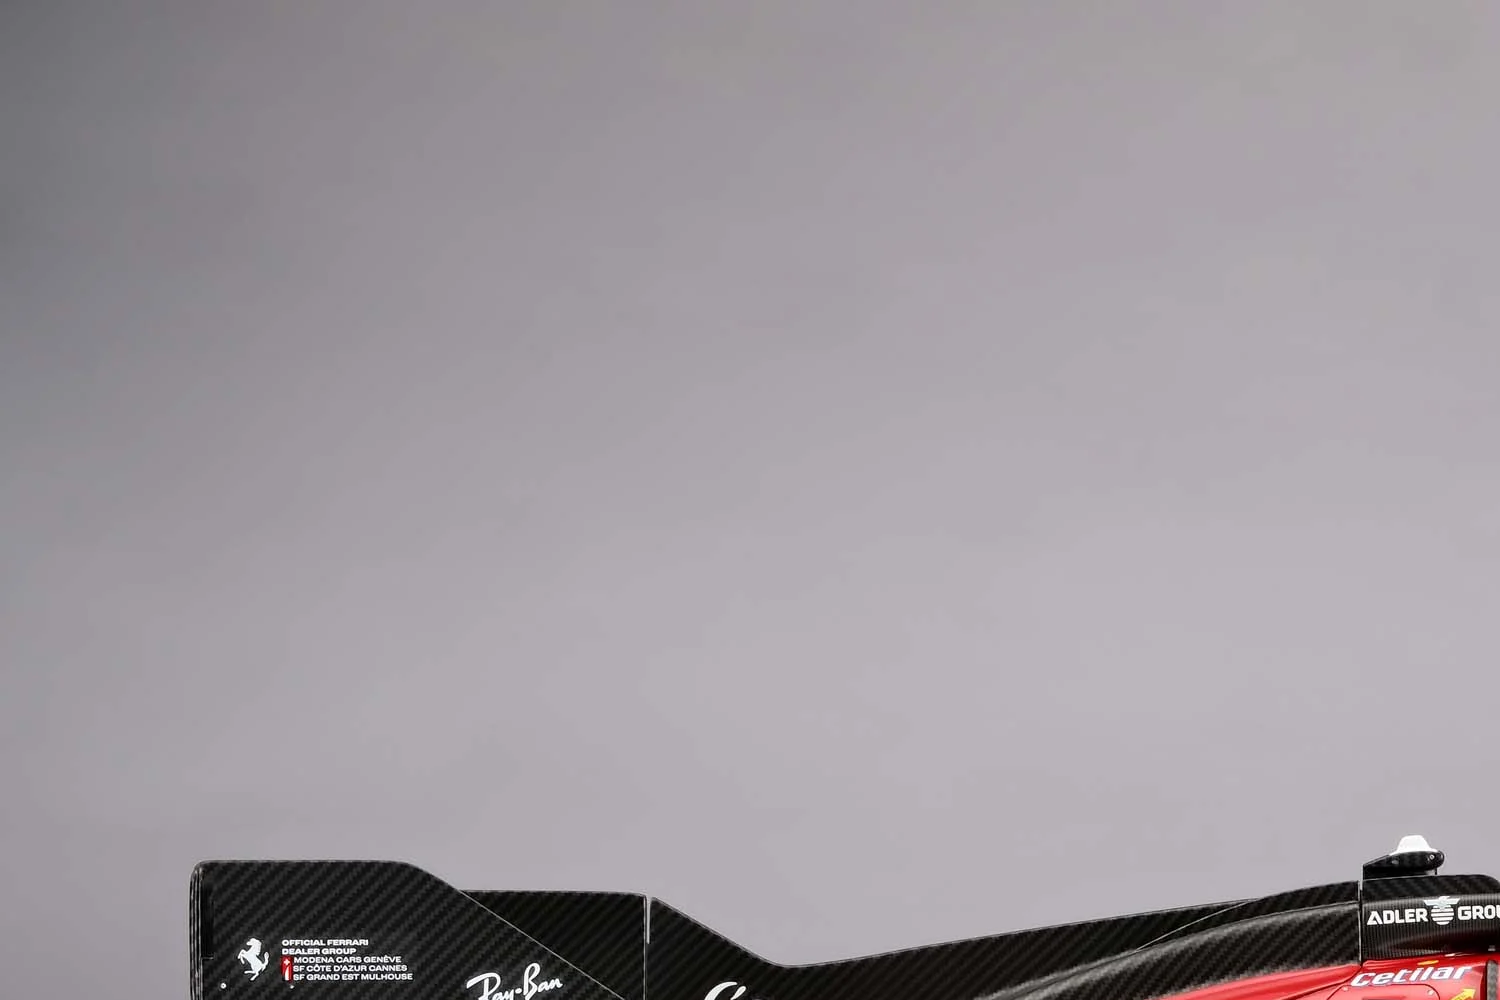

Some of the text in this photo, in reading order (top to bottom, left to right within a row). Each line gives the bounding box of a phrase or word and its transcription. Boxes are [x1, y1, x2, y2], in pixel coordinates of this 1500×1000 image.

[1367, 908, 1428, 925] ADLER
[364, 955, 402, 963] GENÈVE
[306, 964, 331, 972] CÔTE
